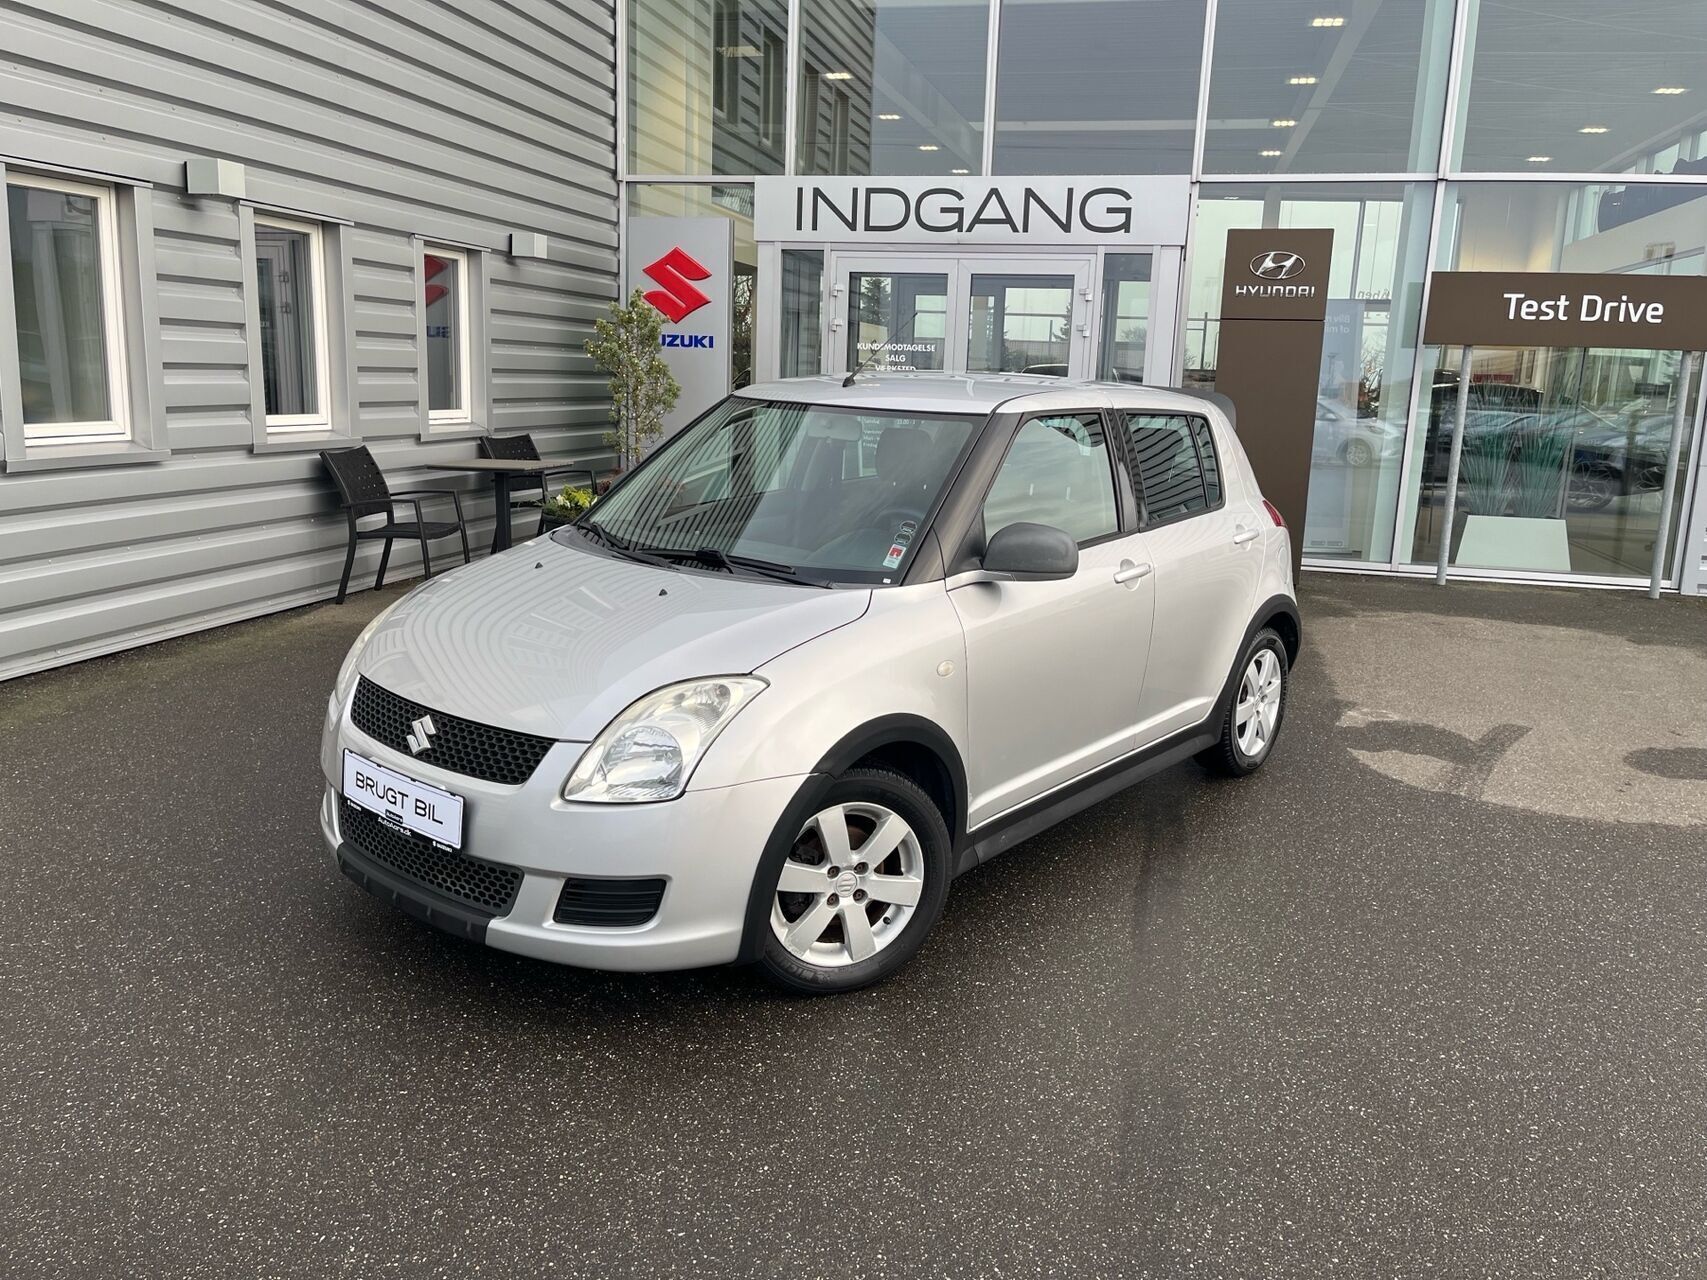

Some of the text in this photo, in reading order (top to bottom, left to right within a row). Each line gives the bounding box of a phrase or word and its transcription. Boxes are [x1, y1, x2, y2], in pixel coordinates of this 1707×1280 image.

[795, 187, 1133, 234] INDGANG
[1235, 285, 1315, 298] HYUNDAI
[1503, 293, 1665, 324] Test Drive
[661, 334, 714, 349] ZUKI
[885, 354, 906, 362] SALG
[356, 771, 443, 825] BRUGT BIL
